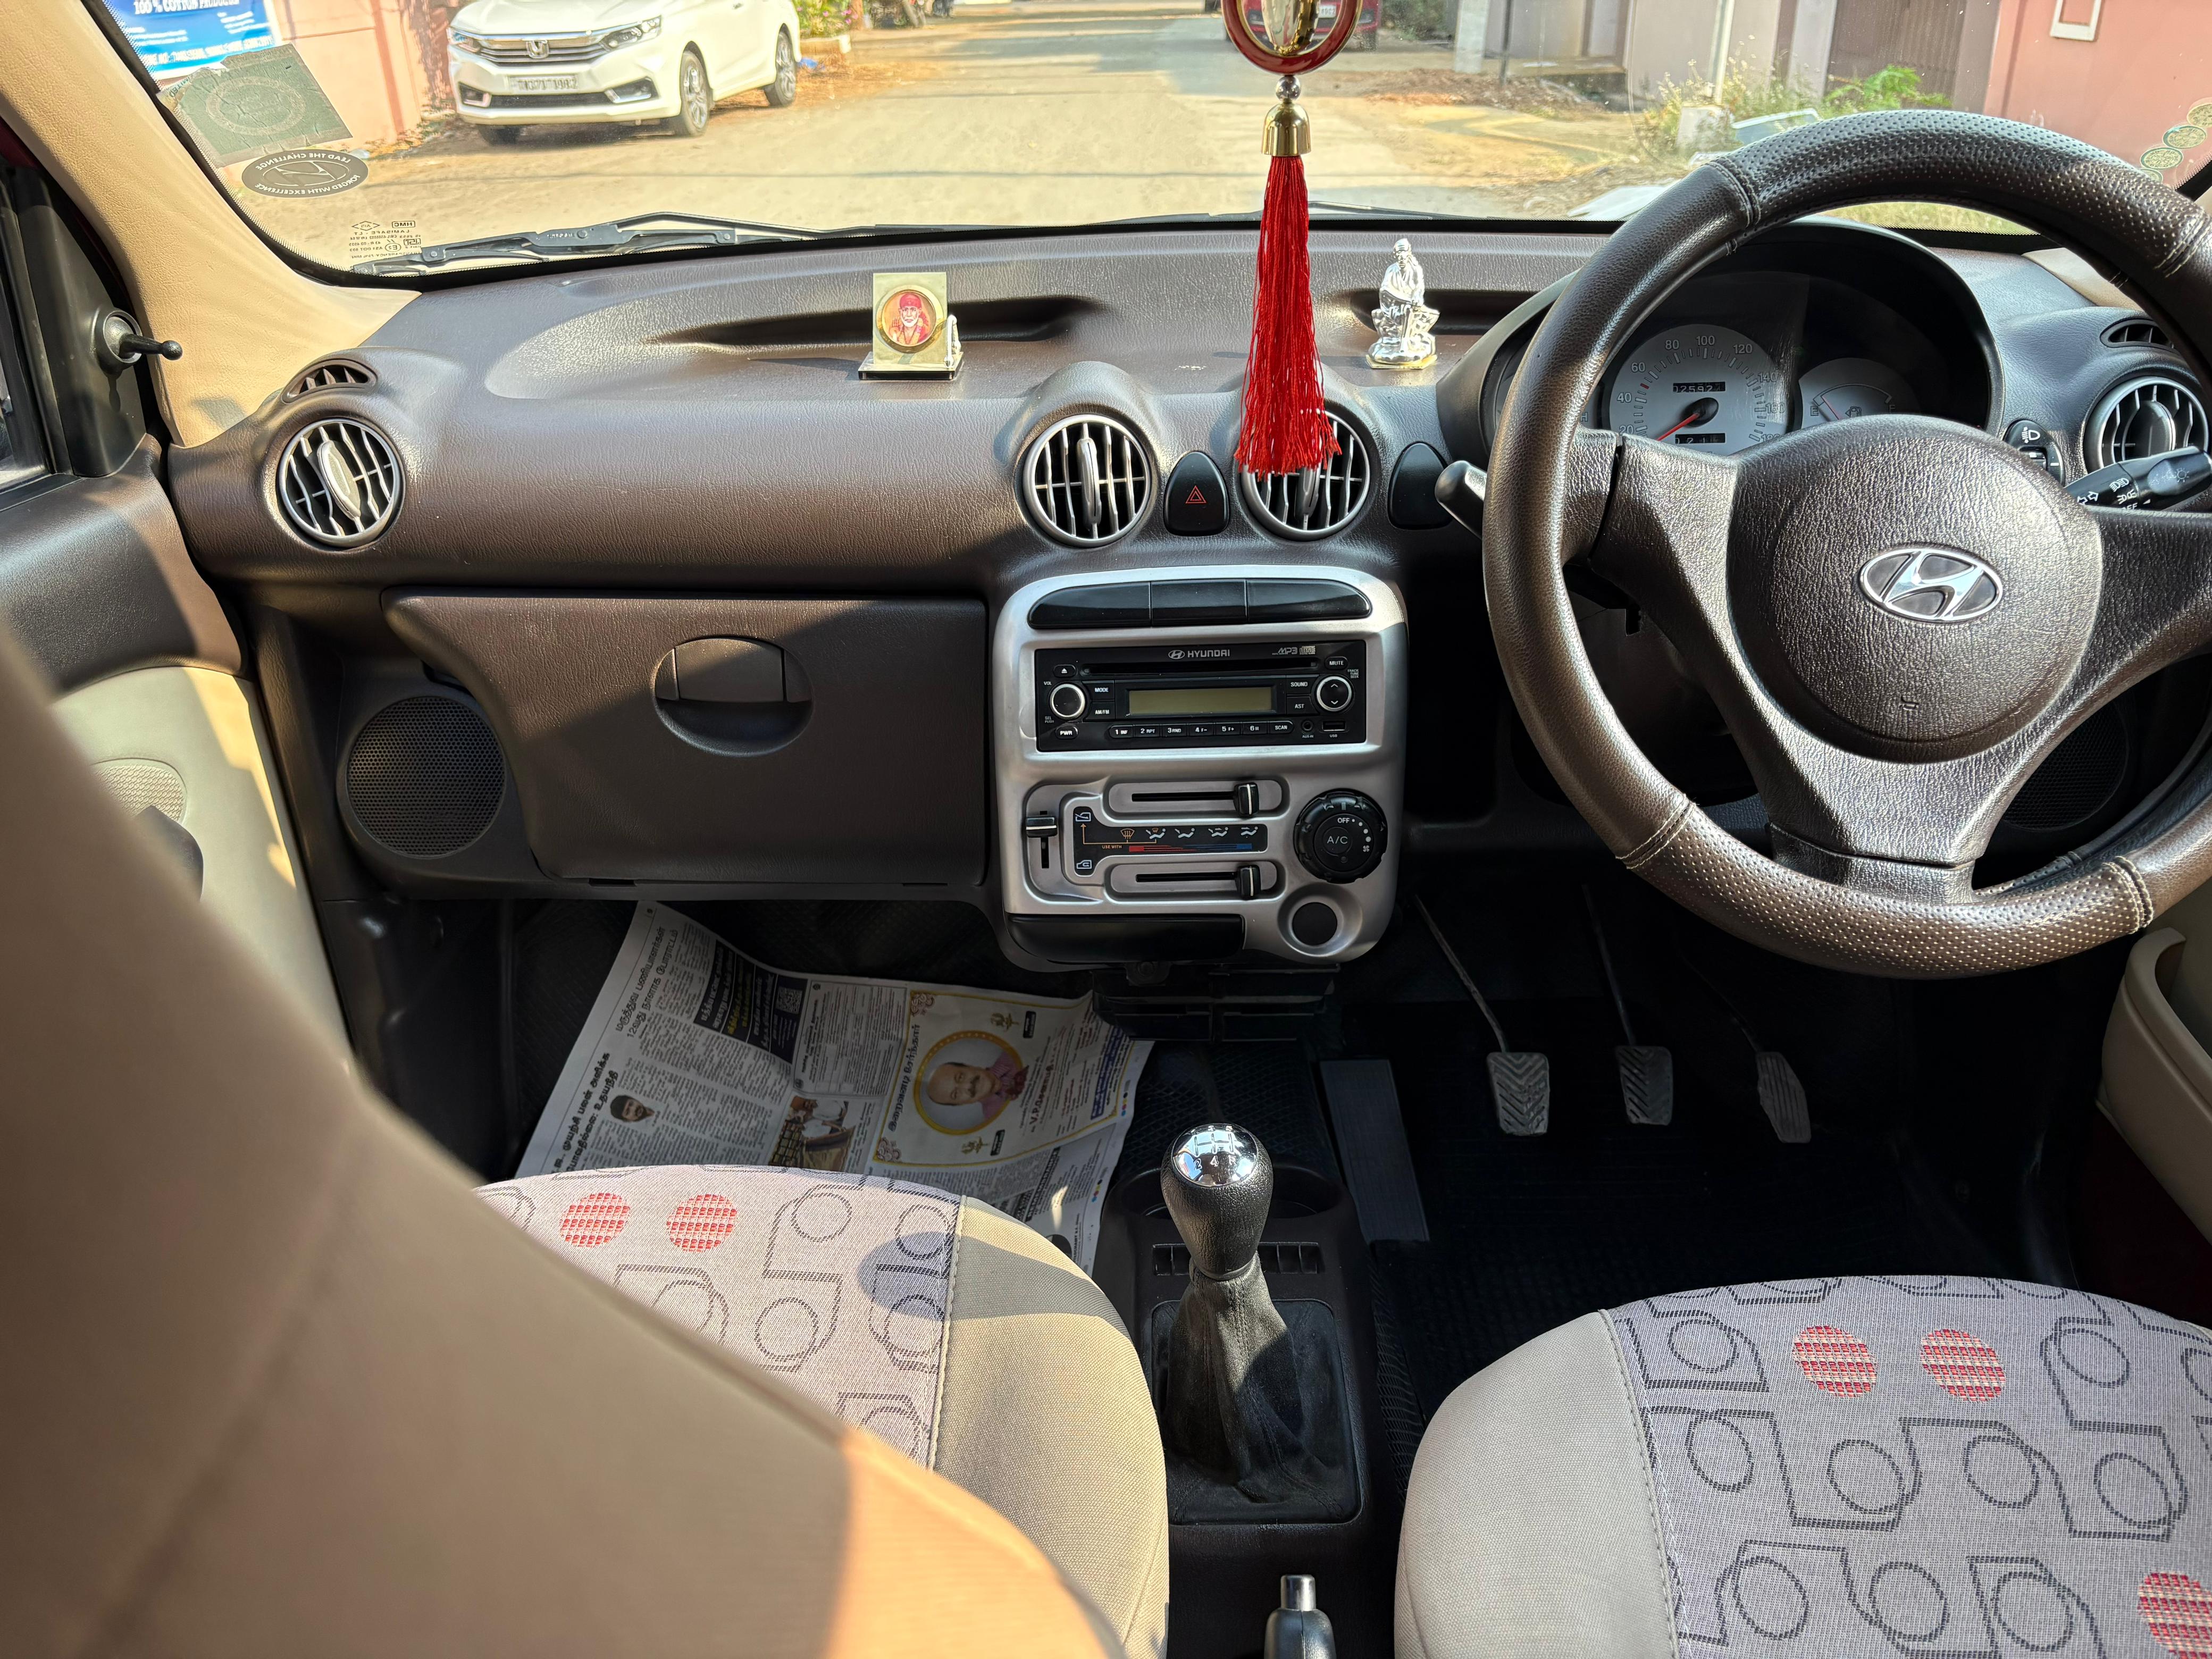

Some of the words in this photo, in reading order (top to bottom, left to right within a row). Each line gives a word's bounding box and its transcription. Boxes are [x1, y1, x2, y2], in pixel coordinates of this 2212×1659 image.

[1665, 340, 1680, 350] 80
[1696, 336, 1715, 346] 100
[1733, 344, 1753, 354] 120
[1631, 362, 1646, 373] 60
[1757, 373, 1778, 382] 140
[1617, 392, 1632, 403] 40
[1811, 406, 1819, 416] E
[1619, 425, 1634, 434] 20
[1187, 649, 1230, 658] HYUNDAI
[1327, 836, 1348, 844] A/C
[1194, 1158, 1202, 1170] 2
[1210, 1155, 1219, 1167] 4
